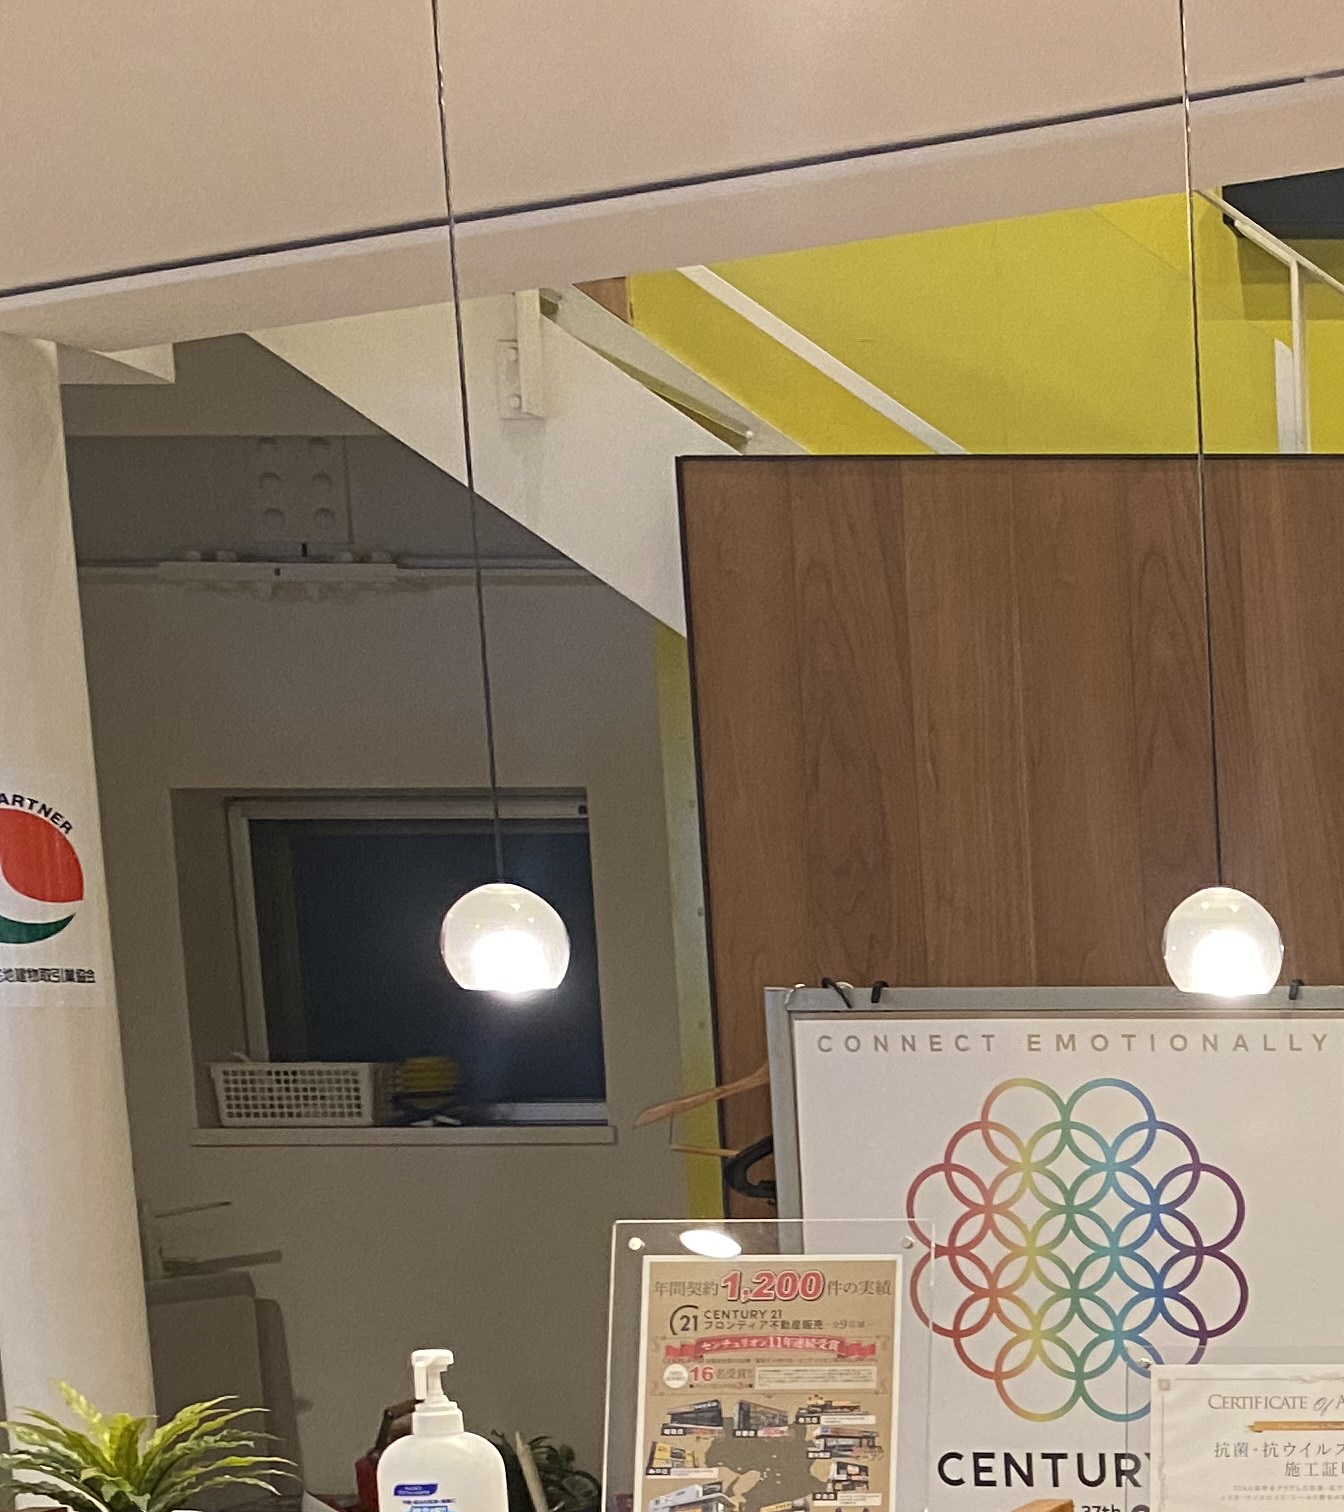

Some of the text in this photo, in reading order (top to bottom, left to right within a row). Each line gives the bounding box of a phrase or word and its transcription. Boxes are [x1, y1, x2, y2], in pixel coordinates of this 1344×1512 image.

[816, 1033, 1330, 1054] CONNECT EMOTIONALLY
[704, 1310, 783, 1320] CENTURY 21
[704, 1320, 823, 1330] フロンティア不動産販売
[937, 1452, 1150, 1487] CENTUR
